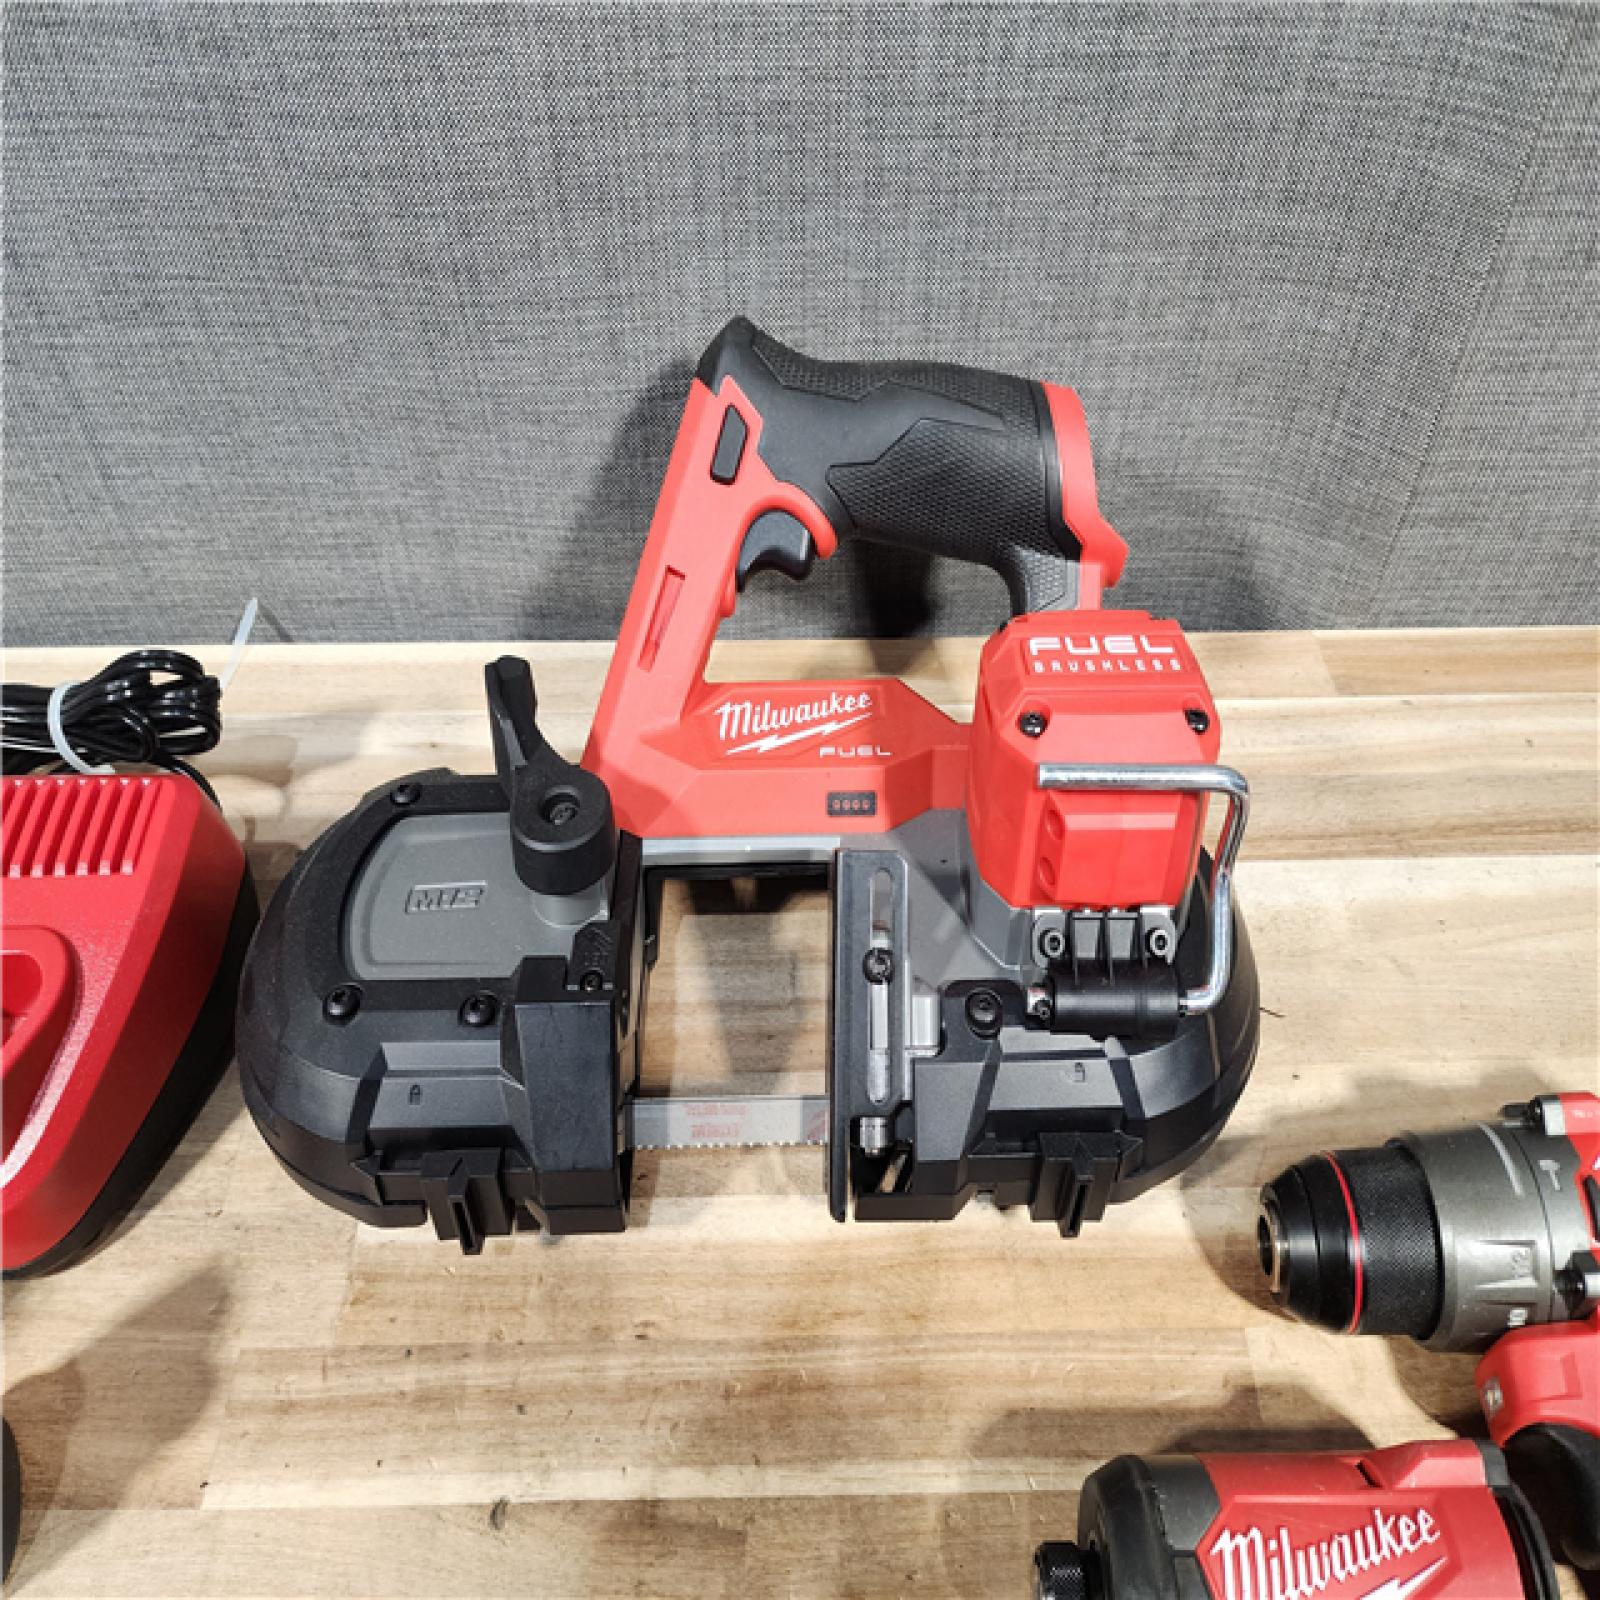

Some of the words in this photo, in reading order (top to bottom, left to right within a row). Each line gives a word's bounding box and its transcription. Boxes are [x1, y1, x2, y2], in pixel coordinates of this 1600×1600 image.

[1029, 635, 1174, 656] FUEL
[1034, 658, 1182, 673] BRUSHLESS
[713, 692, 873, 741] Milwaukee
[819, 744, 892, 758] FUEL
[1209, 1507, 1441, 1600] Milwaukee
